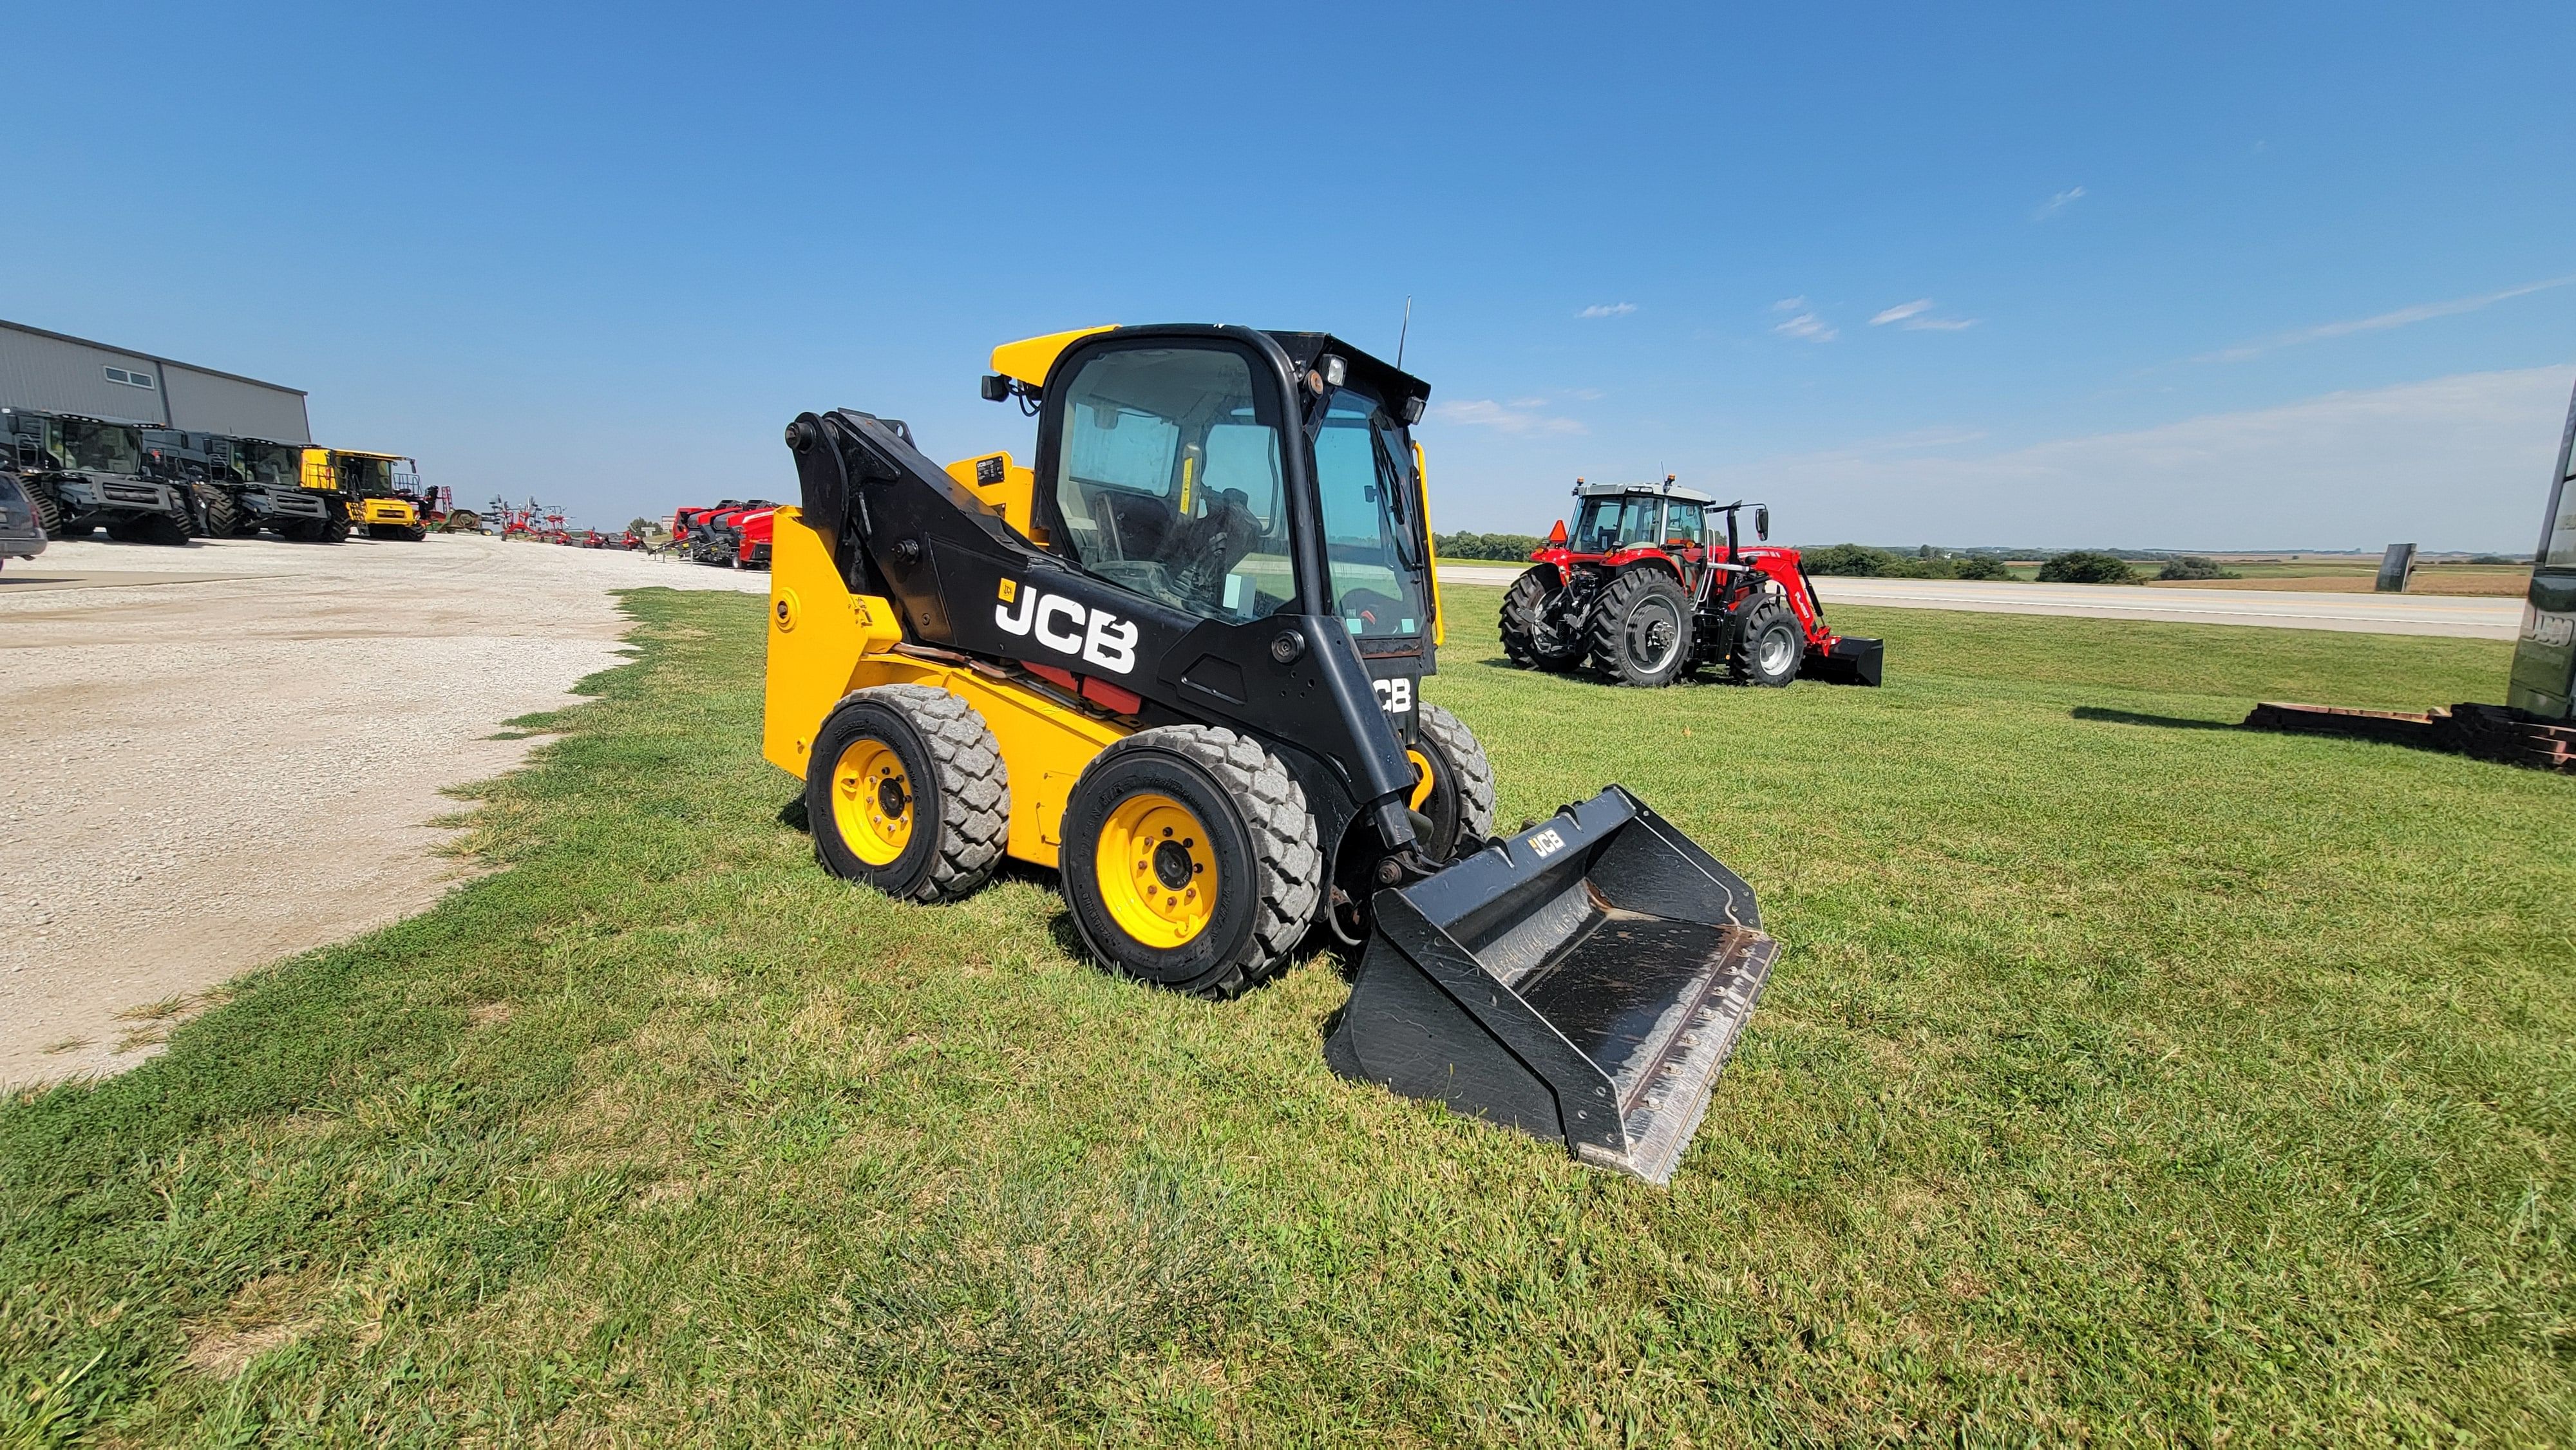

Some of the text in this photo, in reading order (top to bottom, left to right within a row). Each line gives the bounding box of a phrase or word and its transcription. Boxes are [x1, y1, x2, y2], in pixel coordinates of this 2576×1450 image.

[996, 585, 1139, 674] JCB
[1372, 678, 1412, 713] CB
[1529, 829, 1564, 857] JCB
